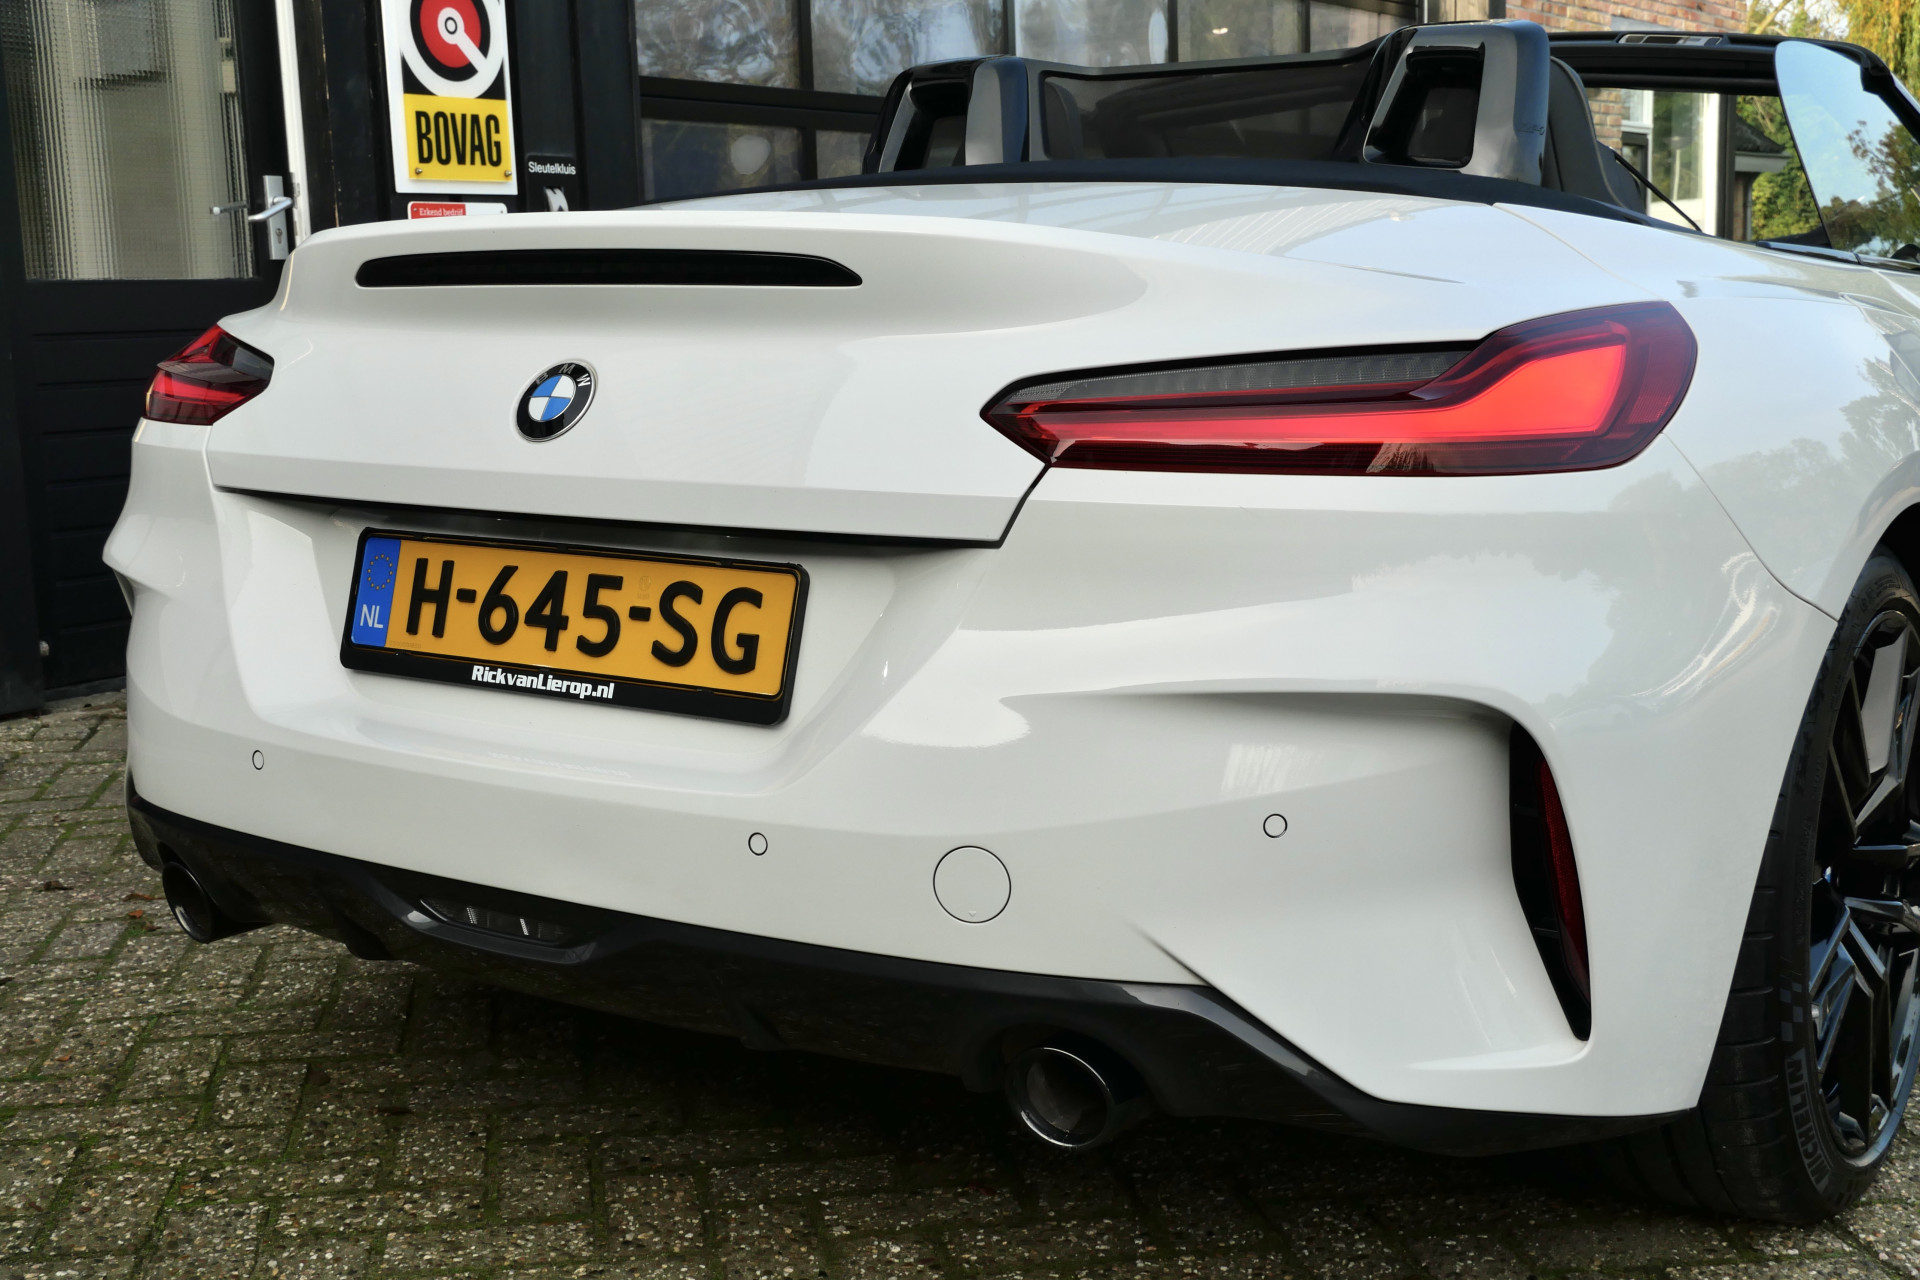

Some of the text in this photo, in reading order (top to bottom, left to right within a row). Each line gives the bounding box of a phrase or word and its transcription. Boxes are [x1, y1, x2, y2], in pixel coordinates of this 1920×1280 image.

[414, 110, 502, 167] BOVAG
[528, 161, 576, 175] Sleutelkluis
[419, 207, 442, 216] Erkend
[535, 363, 591, 387] BMW
[360, 604, 384, 629] NL
[405, 557, 764, 676] H-645-SG
[471, 665, 614, 699] RickvanLierop.nl
[1787, 1058, 1830, 1186] MICHELIN
